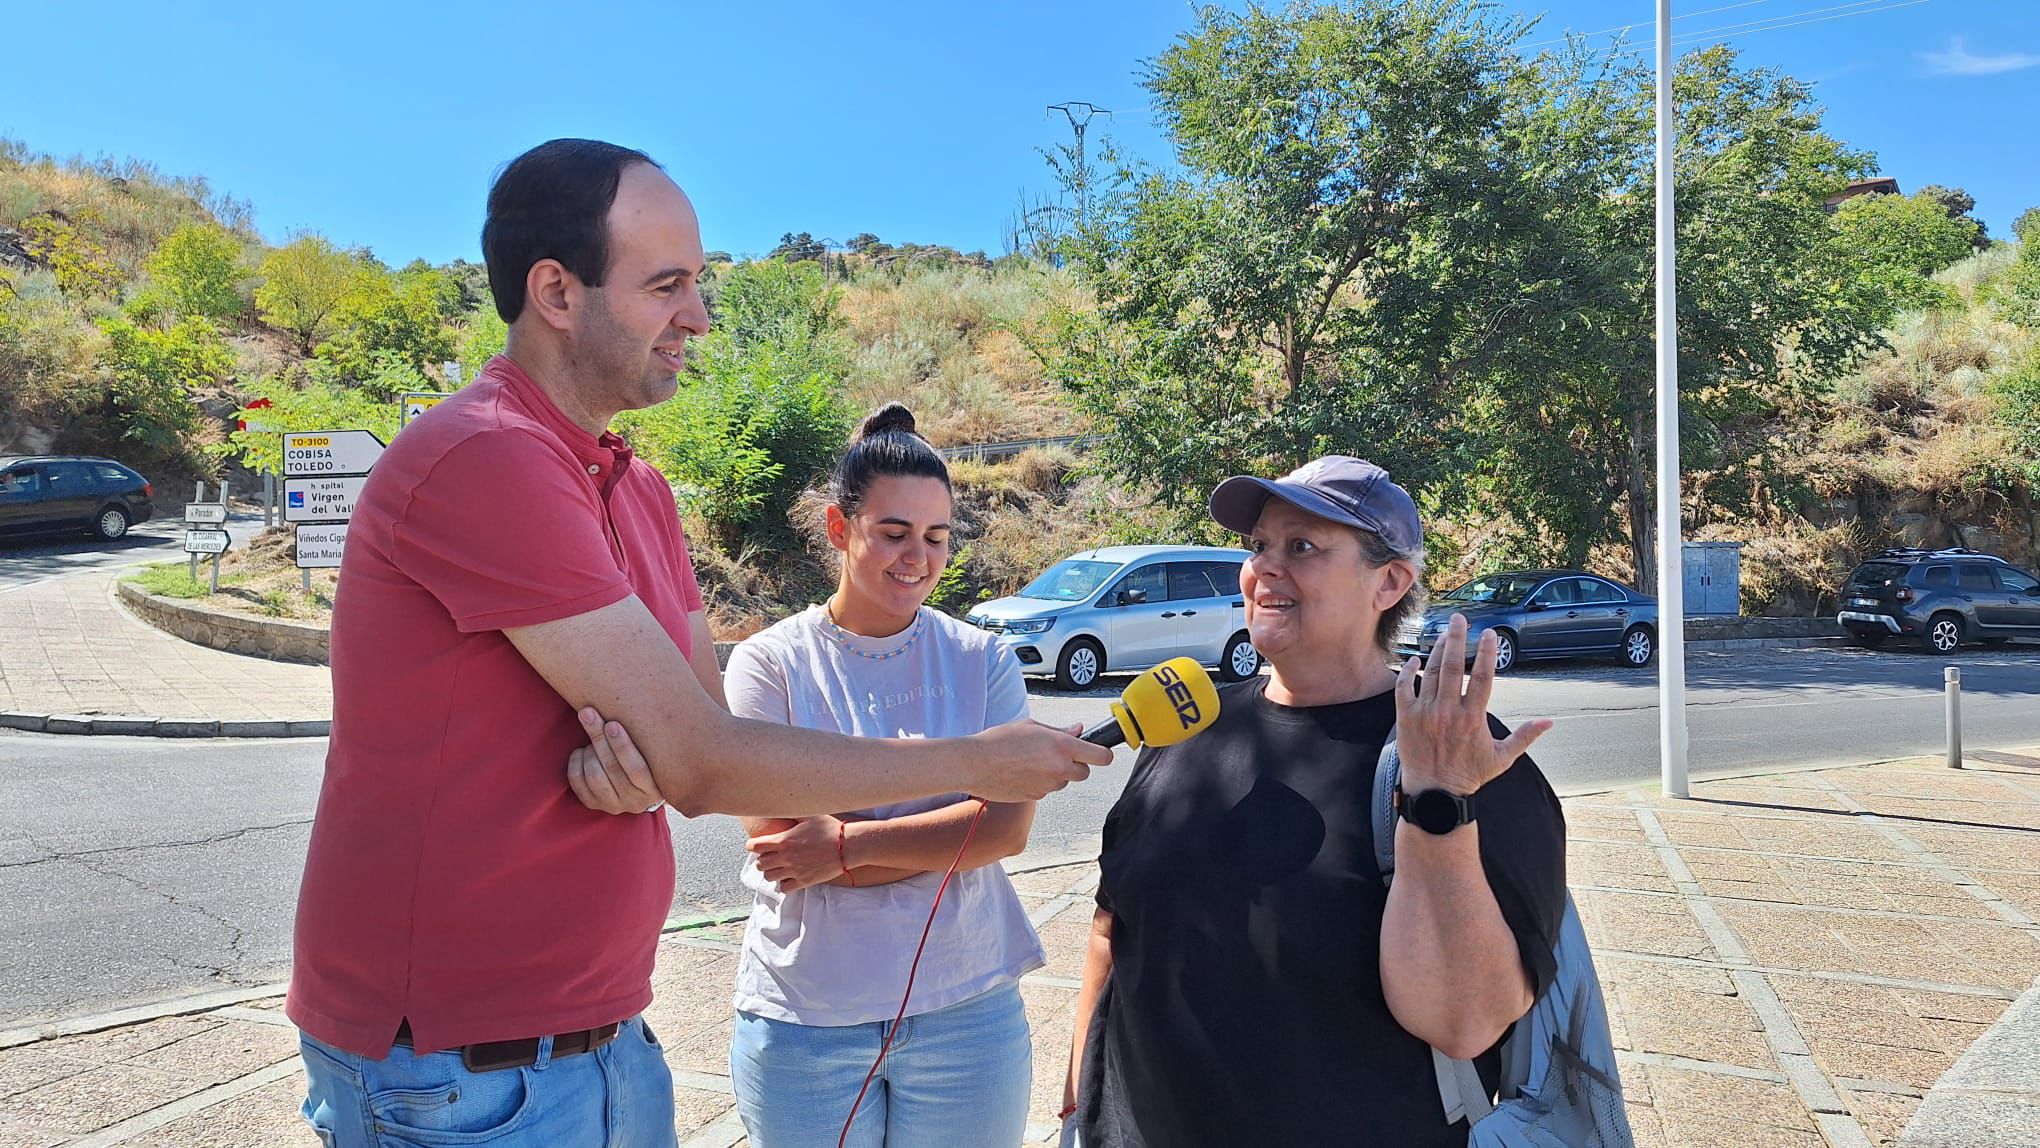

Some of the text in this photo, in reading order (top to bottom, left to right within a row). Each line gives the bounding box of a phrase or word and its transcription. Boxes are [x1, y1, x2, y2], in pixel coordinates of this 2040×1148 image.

[292, 438, 329, 446] TO-3100
[288, 449, 332, 459] COBISA
[288, 461, 333, 472] TOLEDO
[311, 493, 344, 503] Virgen
[311, 505, 328, 514] del
[298, 533, 328, 543] Viñedos
[298, 549, 319, 559] Santa
[884, 684, 955, 710] EDITION
[1153, 666, 1201, 730] SER
